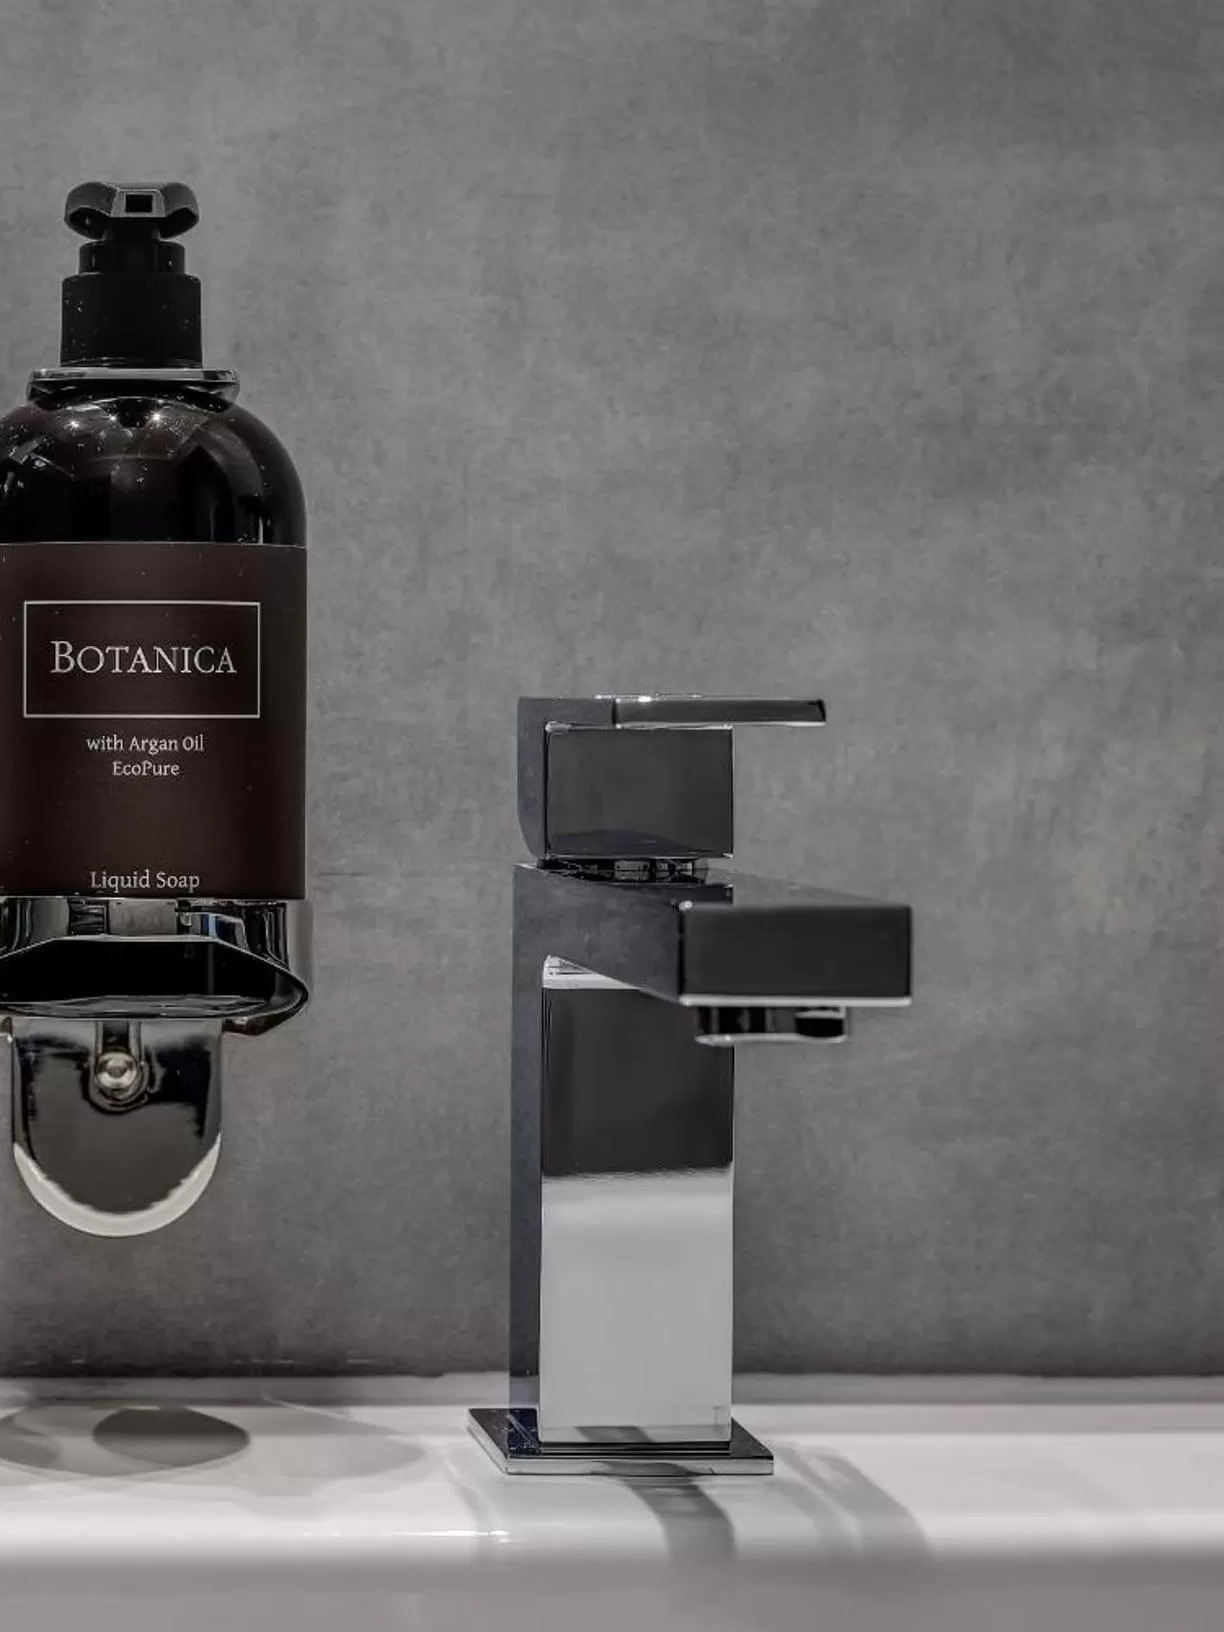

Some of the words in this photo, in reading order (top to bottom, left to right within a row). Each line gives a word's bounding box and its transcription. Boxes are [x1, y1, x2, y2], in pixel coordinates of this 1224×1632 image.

[86, 733, 124, 751] with
[128, 735, 178, 755] Argan
[182, 733, 204, 752] Oil
[112, 759, 180, 776] EcoPure
[90, 868, 151, 893] Liquid
[155, 870, 200, 893] Soap
